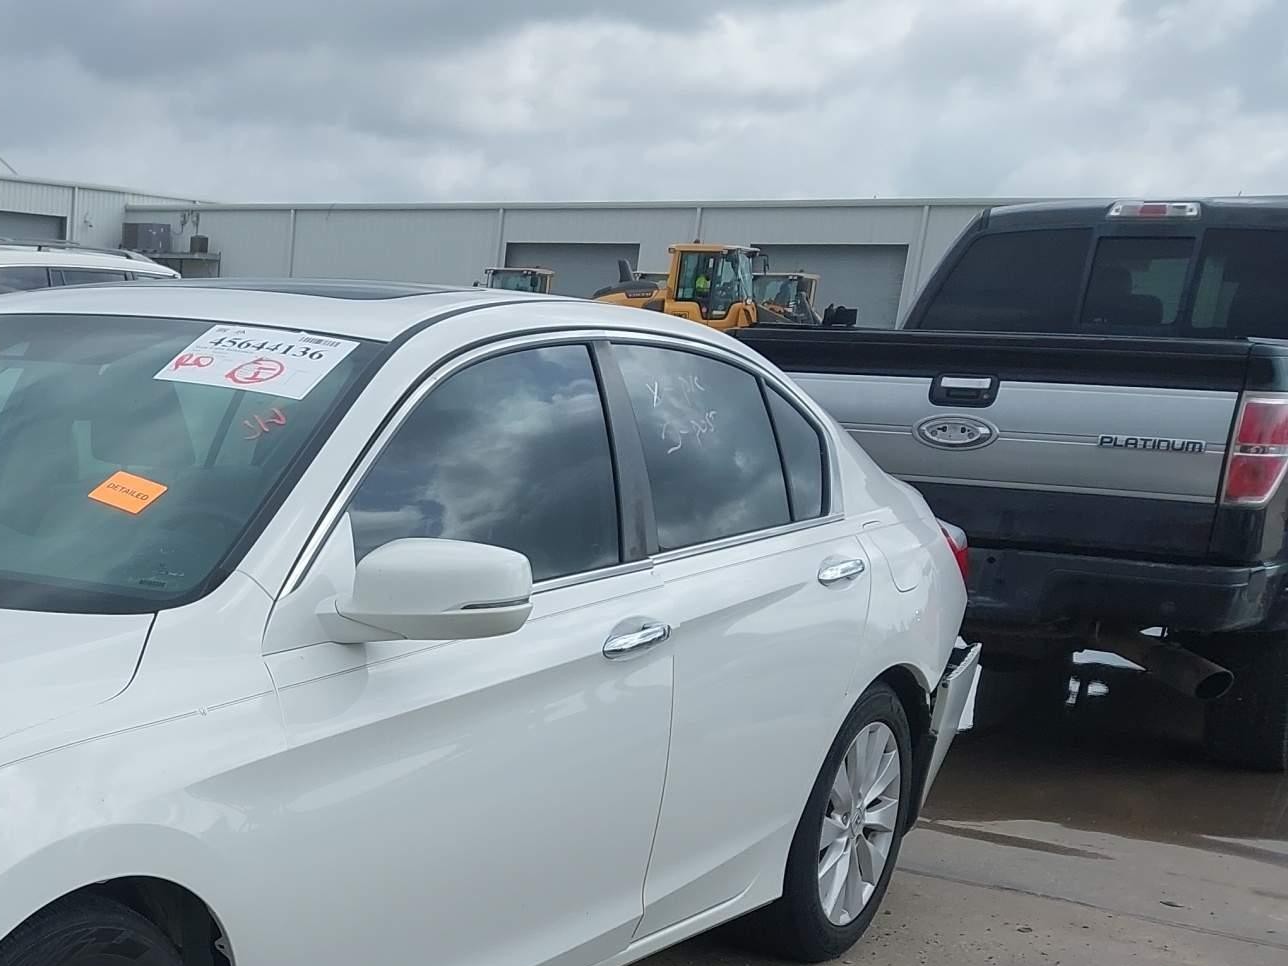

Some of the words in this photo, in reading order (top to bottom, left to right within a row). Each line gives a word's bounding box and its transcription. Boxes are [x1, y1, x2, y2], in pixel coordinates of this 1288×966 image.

[210, 336, 325, 360] 45644136
[1098, 435, 1204, 453] PLATINUM
[106, 481, 150, 502] DETAILED
